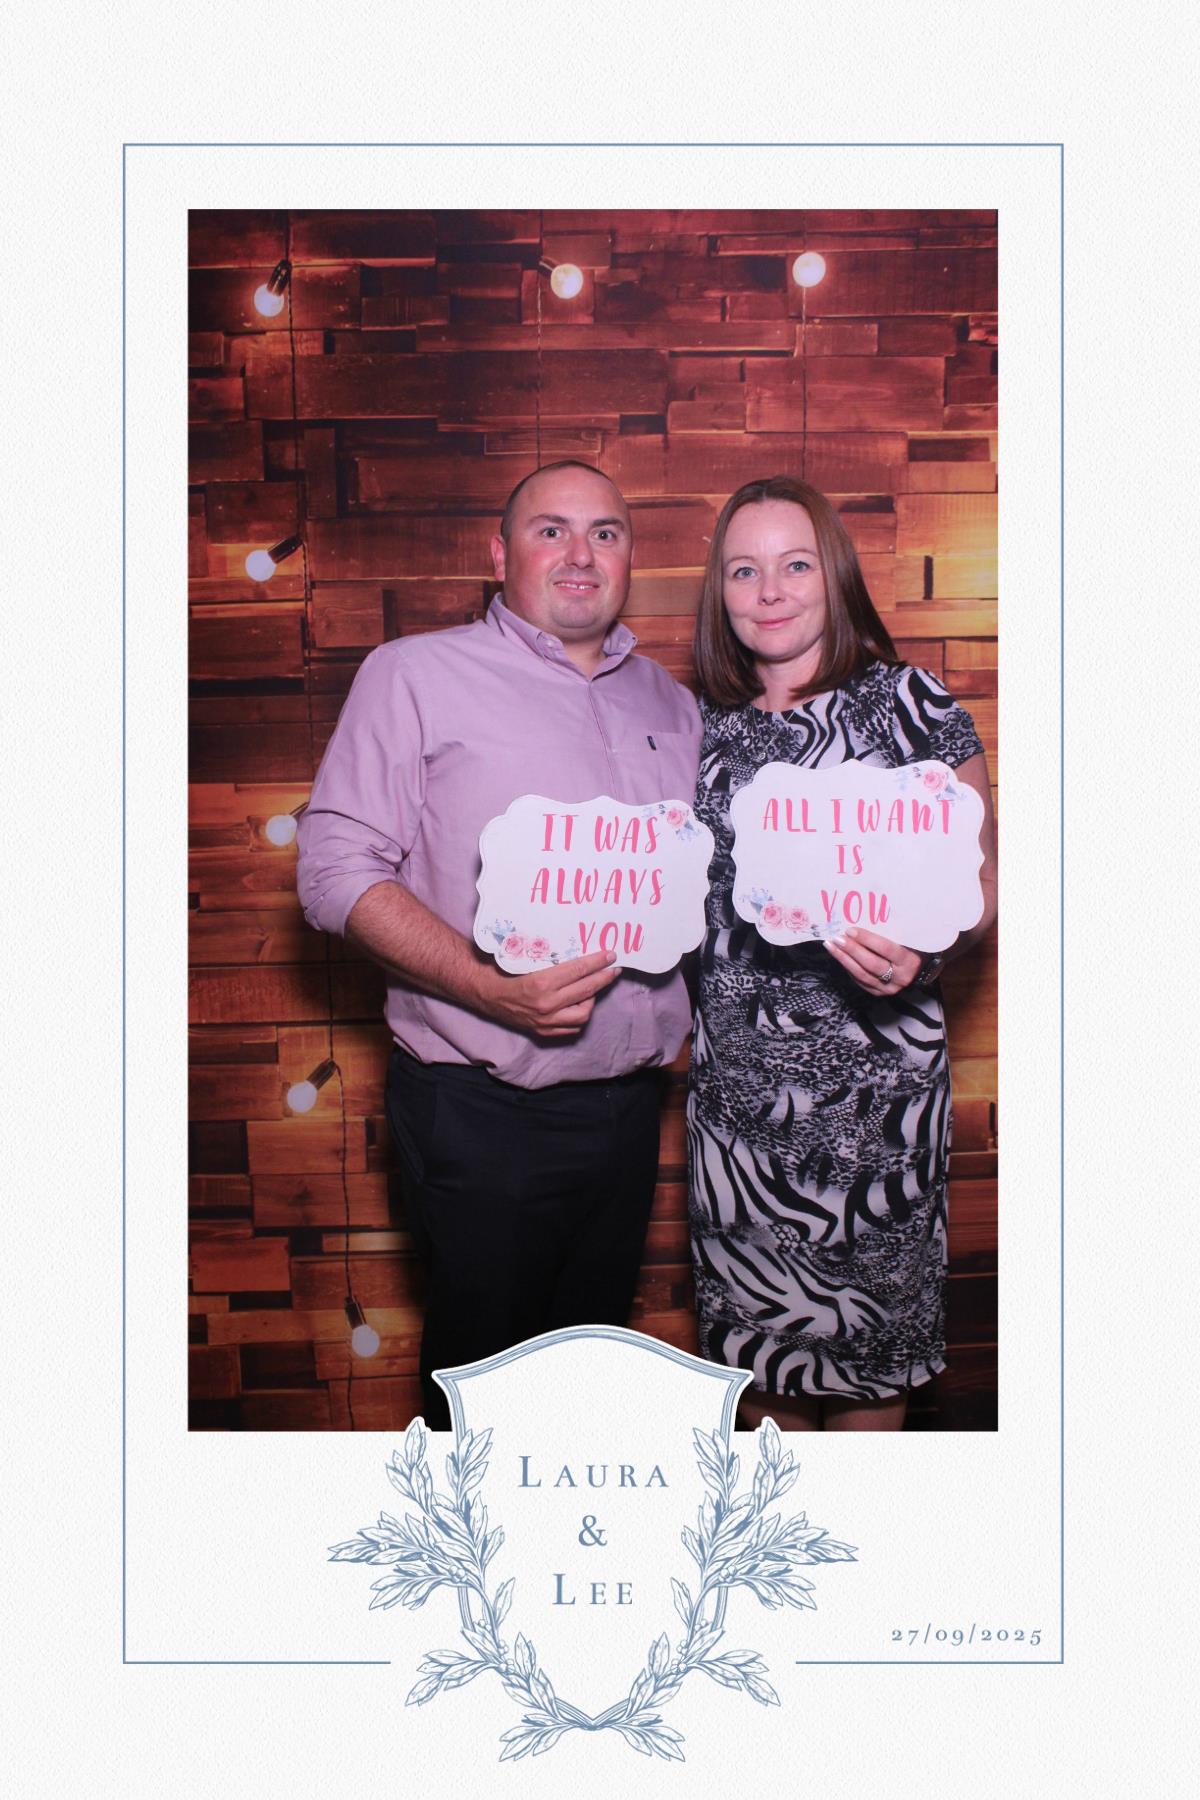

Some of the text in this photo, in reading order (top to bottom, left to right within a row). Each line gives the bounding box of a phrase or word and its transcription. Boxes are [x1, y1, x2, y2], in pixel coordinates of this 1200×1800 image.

[541, 813, 660, 854] IT WAS
[763, 798, 818, 833] ALL
[832, 798, 850, 833] I
[836, 843, 864, 875] IS
[530, 867, 664, 906] ALWAYS
[819, 890, 889, 926] YOU
[577, 920, 645, 956] YOU
